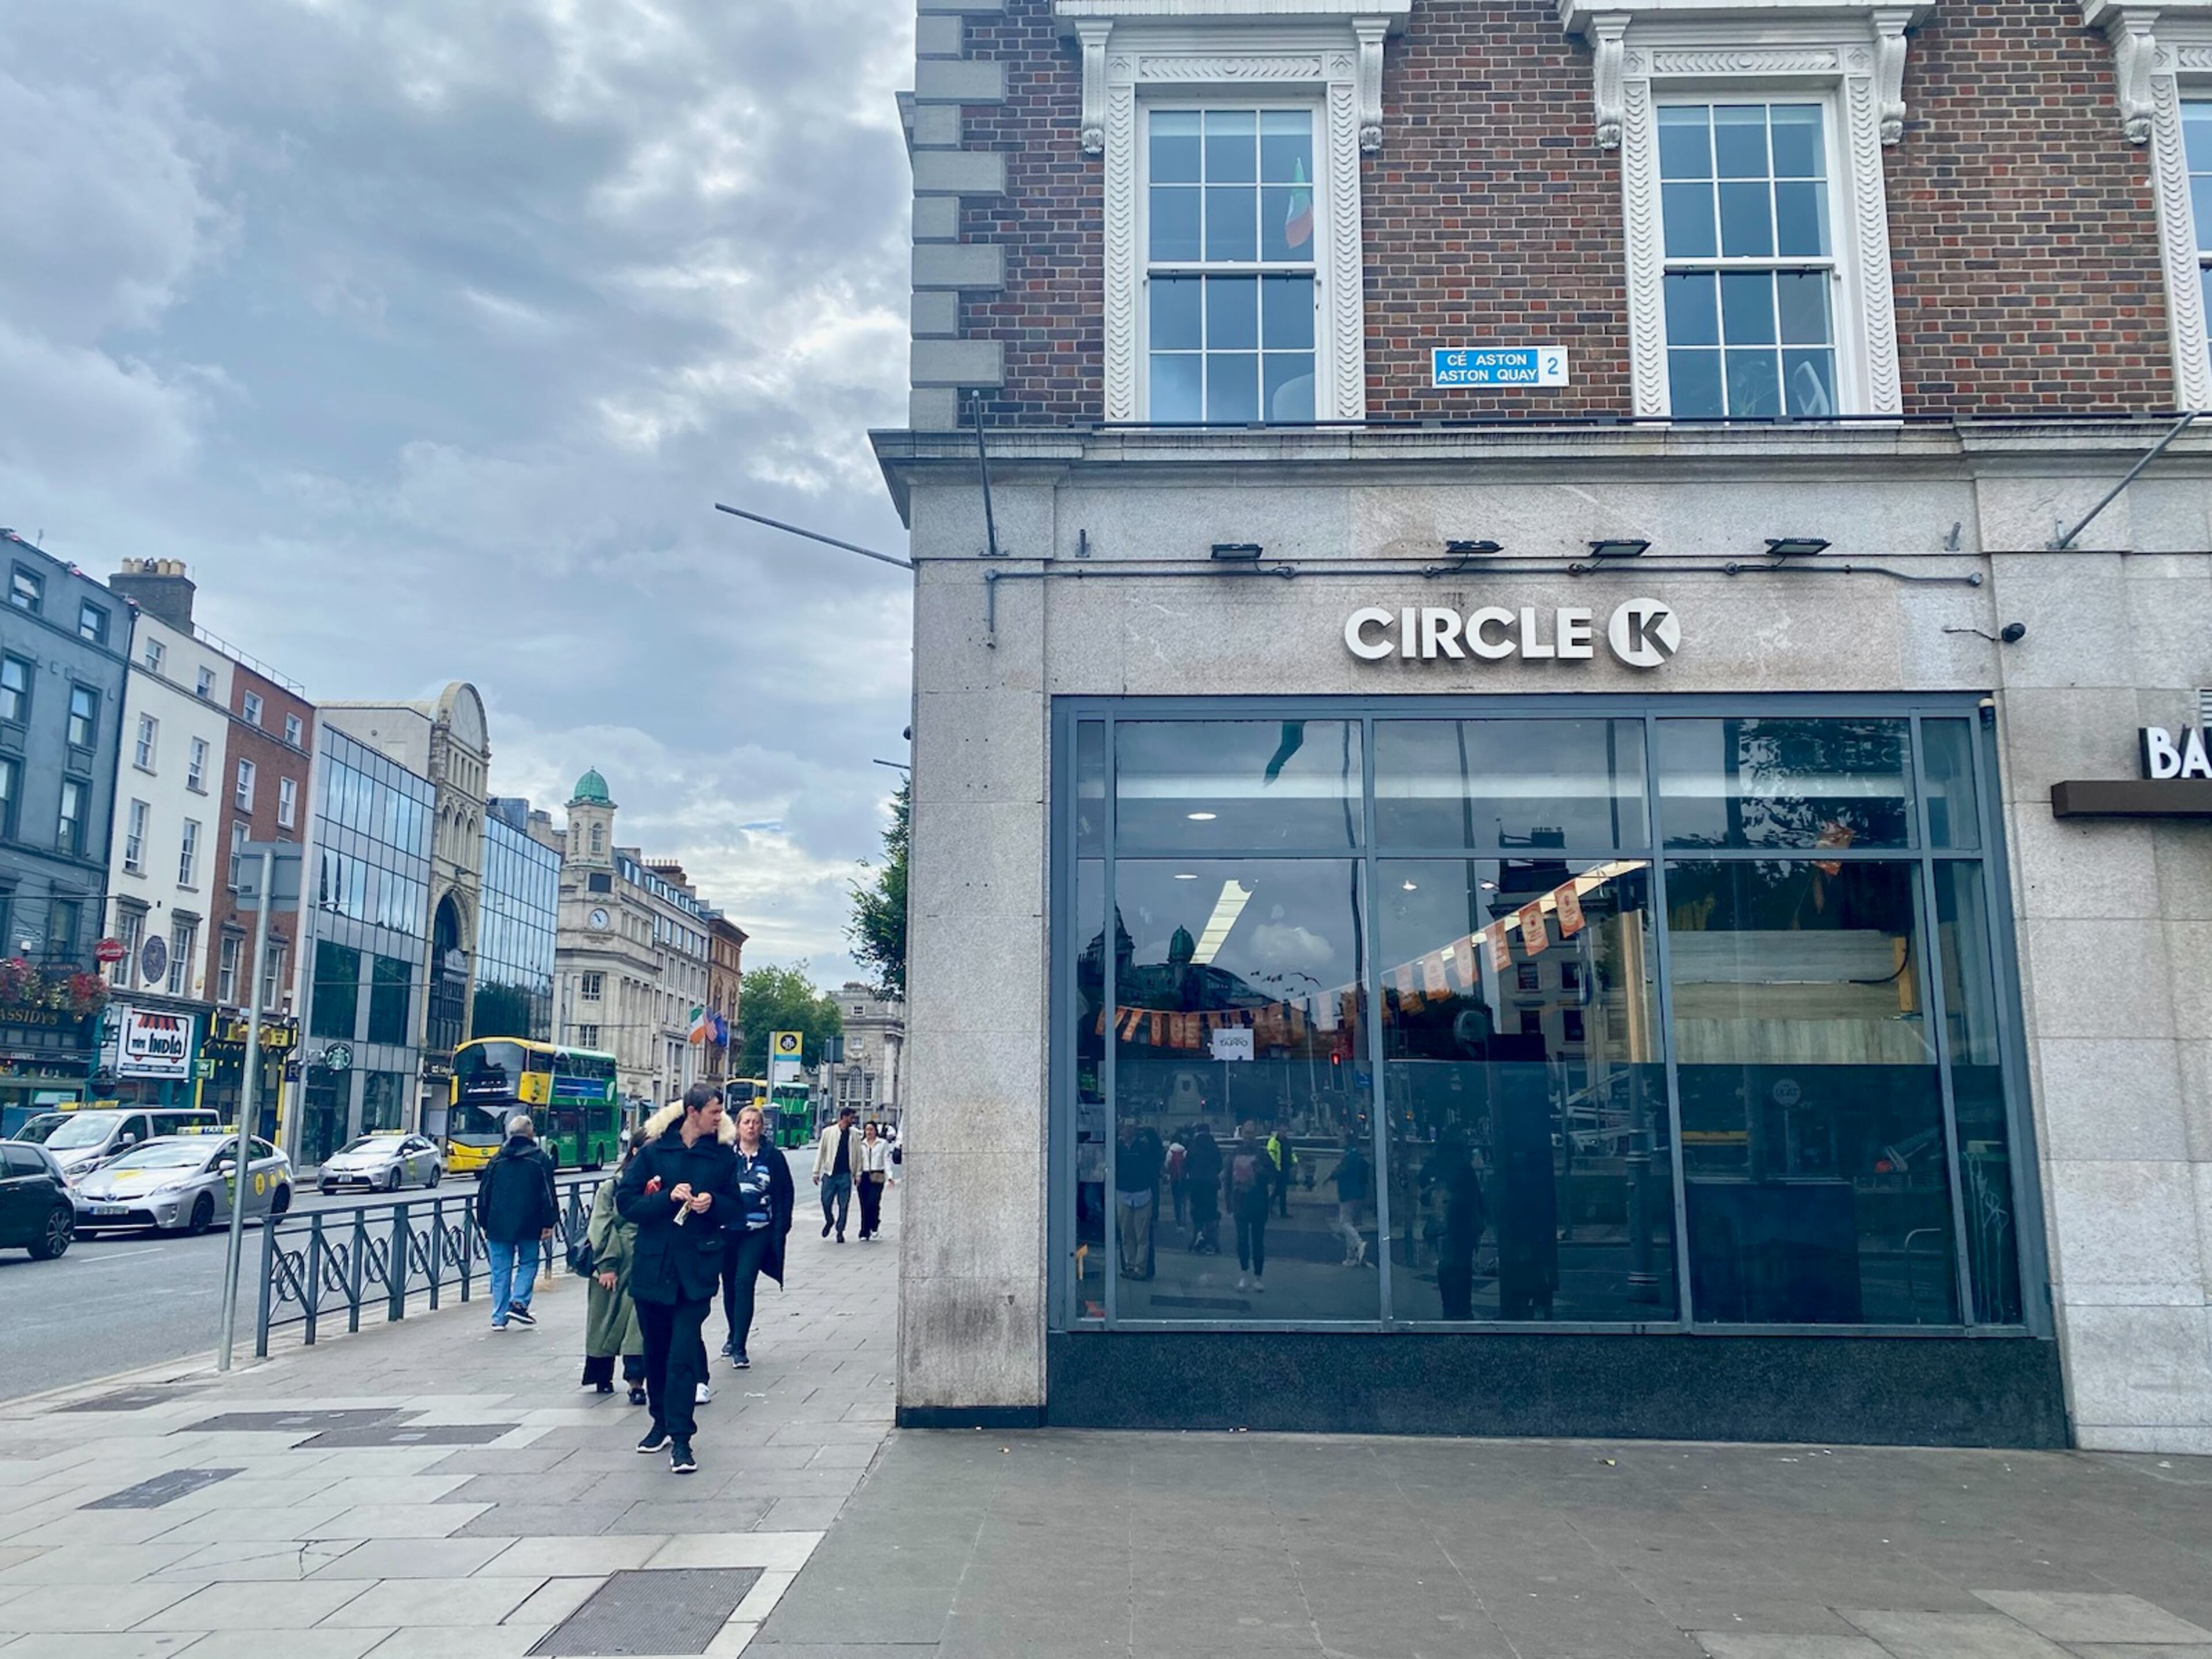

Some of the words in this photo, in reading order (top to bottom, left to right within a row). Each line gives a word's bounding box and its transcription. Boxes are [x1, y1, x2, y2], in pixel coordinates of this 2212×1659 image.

[1446, 351, 1467, 366] CÉ
[1476, 354, 1527, 366] ASTON
[1547, 357, 1558, 374] 2
[1438, 369, 1488, 381] ASTON
[1497, 369, 1537, 381] QUAY
[1344, 606, 1593, 660] CIRCLE
[1616, 603, 1681, 665] K
[2141, 725, 2212, 779] BA
